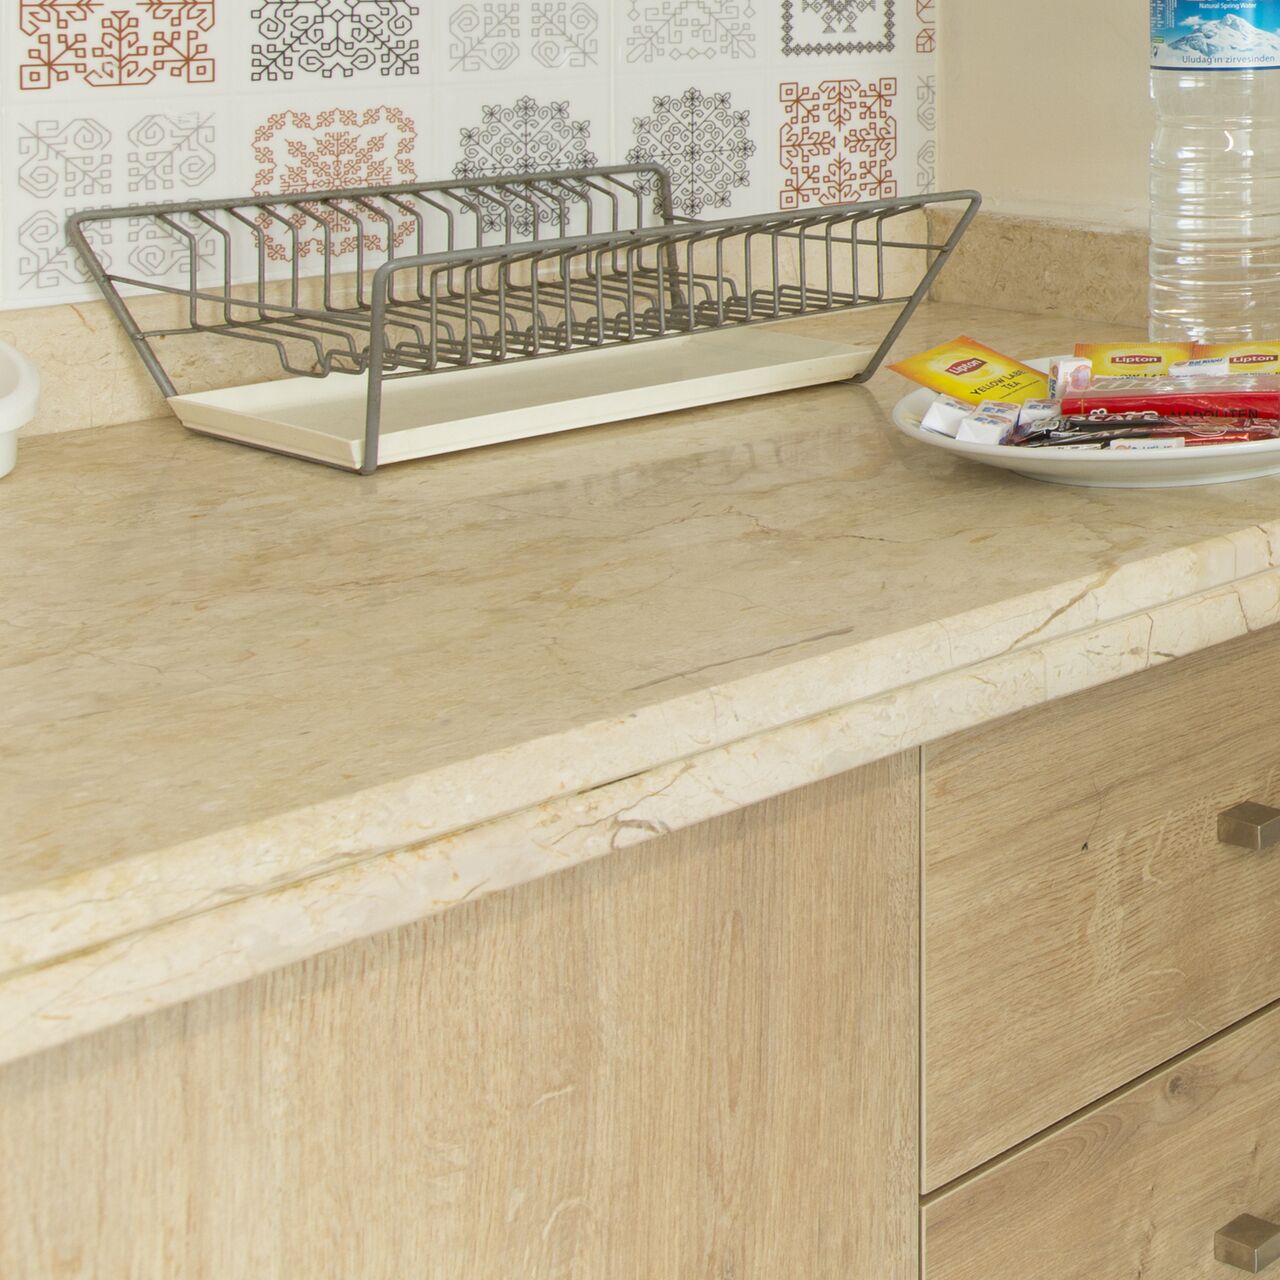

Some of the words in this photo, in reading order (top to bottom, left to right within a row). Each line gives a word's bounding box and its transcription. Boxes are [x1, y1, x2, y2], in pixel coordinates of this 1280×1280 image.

[1221, 2, 1239, 10] Spring
[1225, 54, 1275, 64] zirvesinden
[1115, 356, 1158, 364] Lipton
[1233, 354, 1274, 363] Lipton
[948, 359, 983, 374] Lipton
[970, 377, 1005, 396] YELLOW
[1000, 381, 1022, 390] TEA
